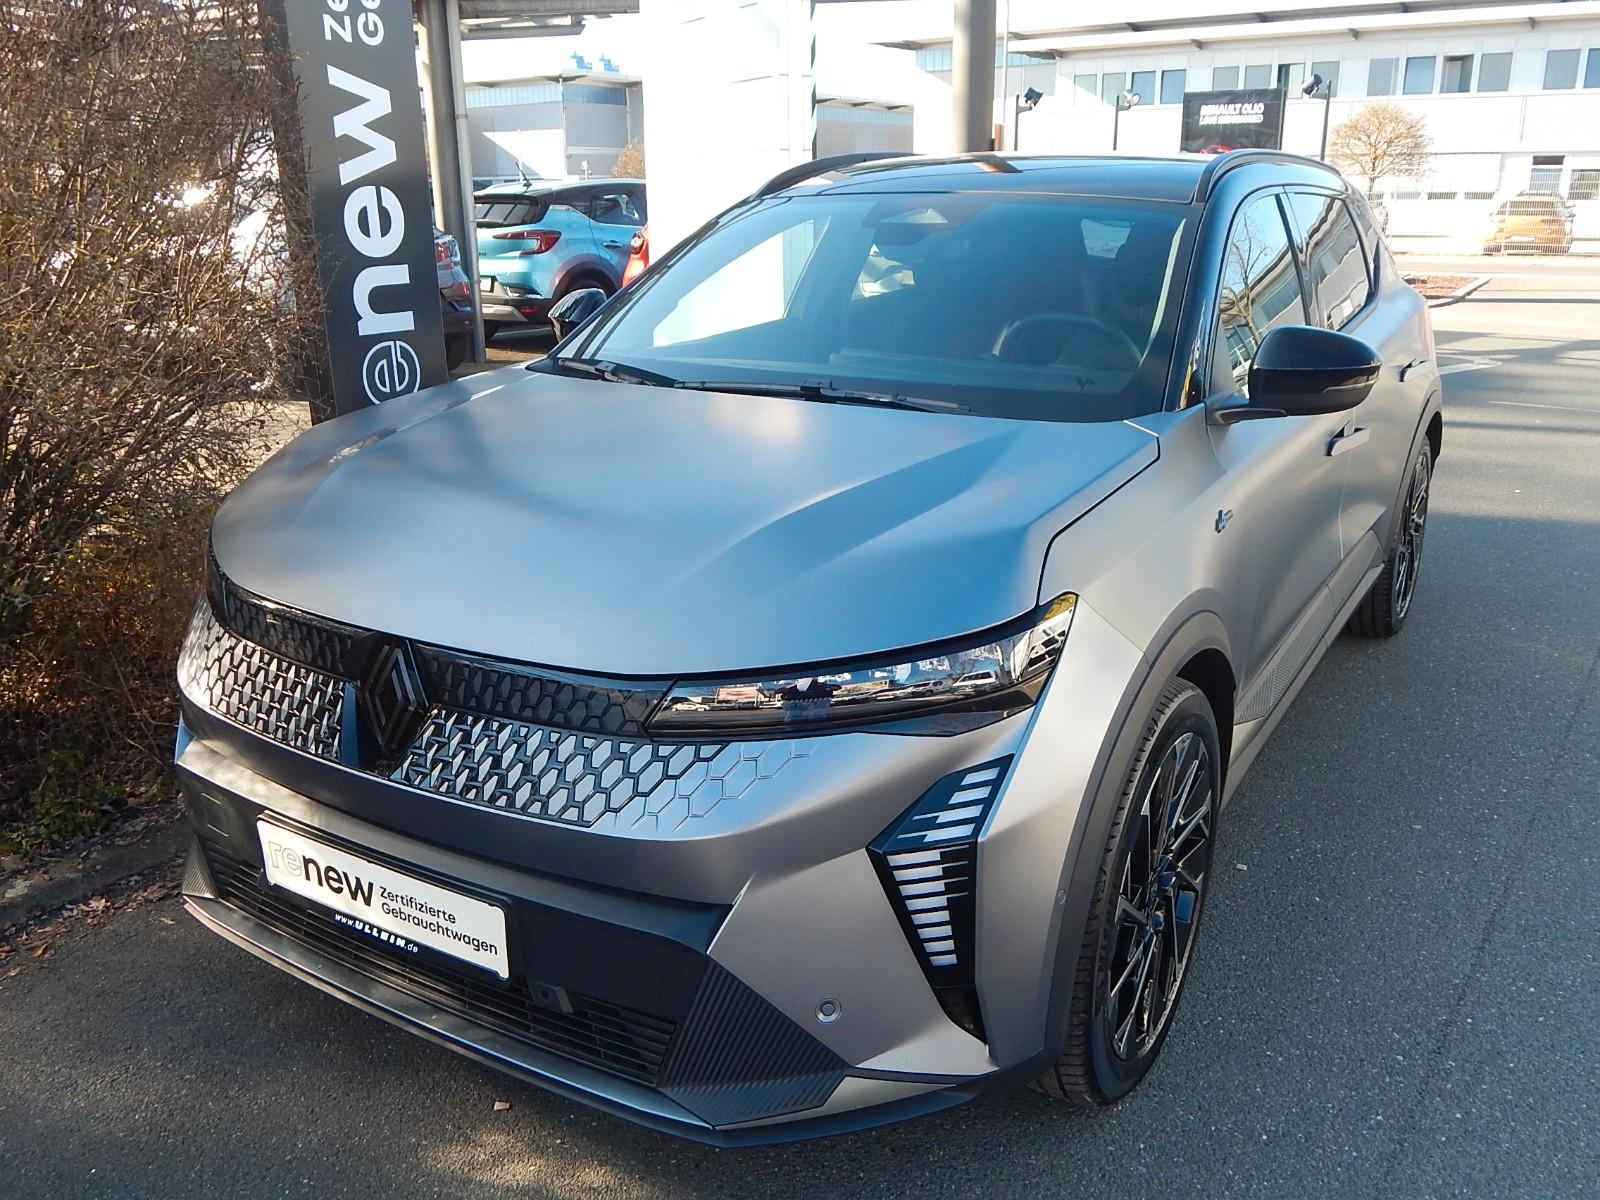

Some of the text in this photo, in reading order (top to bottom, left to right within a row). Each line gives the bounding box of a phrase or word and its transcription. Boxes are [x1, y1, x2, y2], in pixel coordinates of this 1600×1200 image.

[268, 840, 374, 907] renew
[379, 885, 456, 924] Zertifizierte
[381, 902, 498, 955] Gebrauchtwagen
